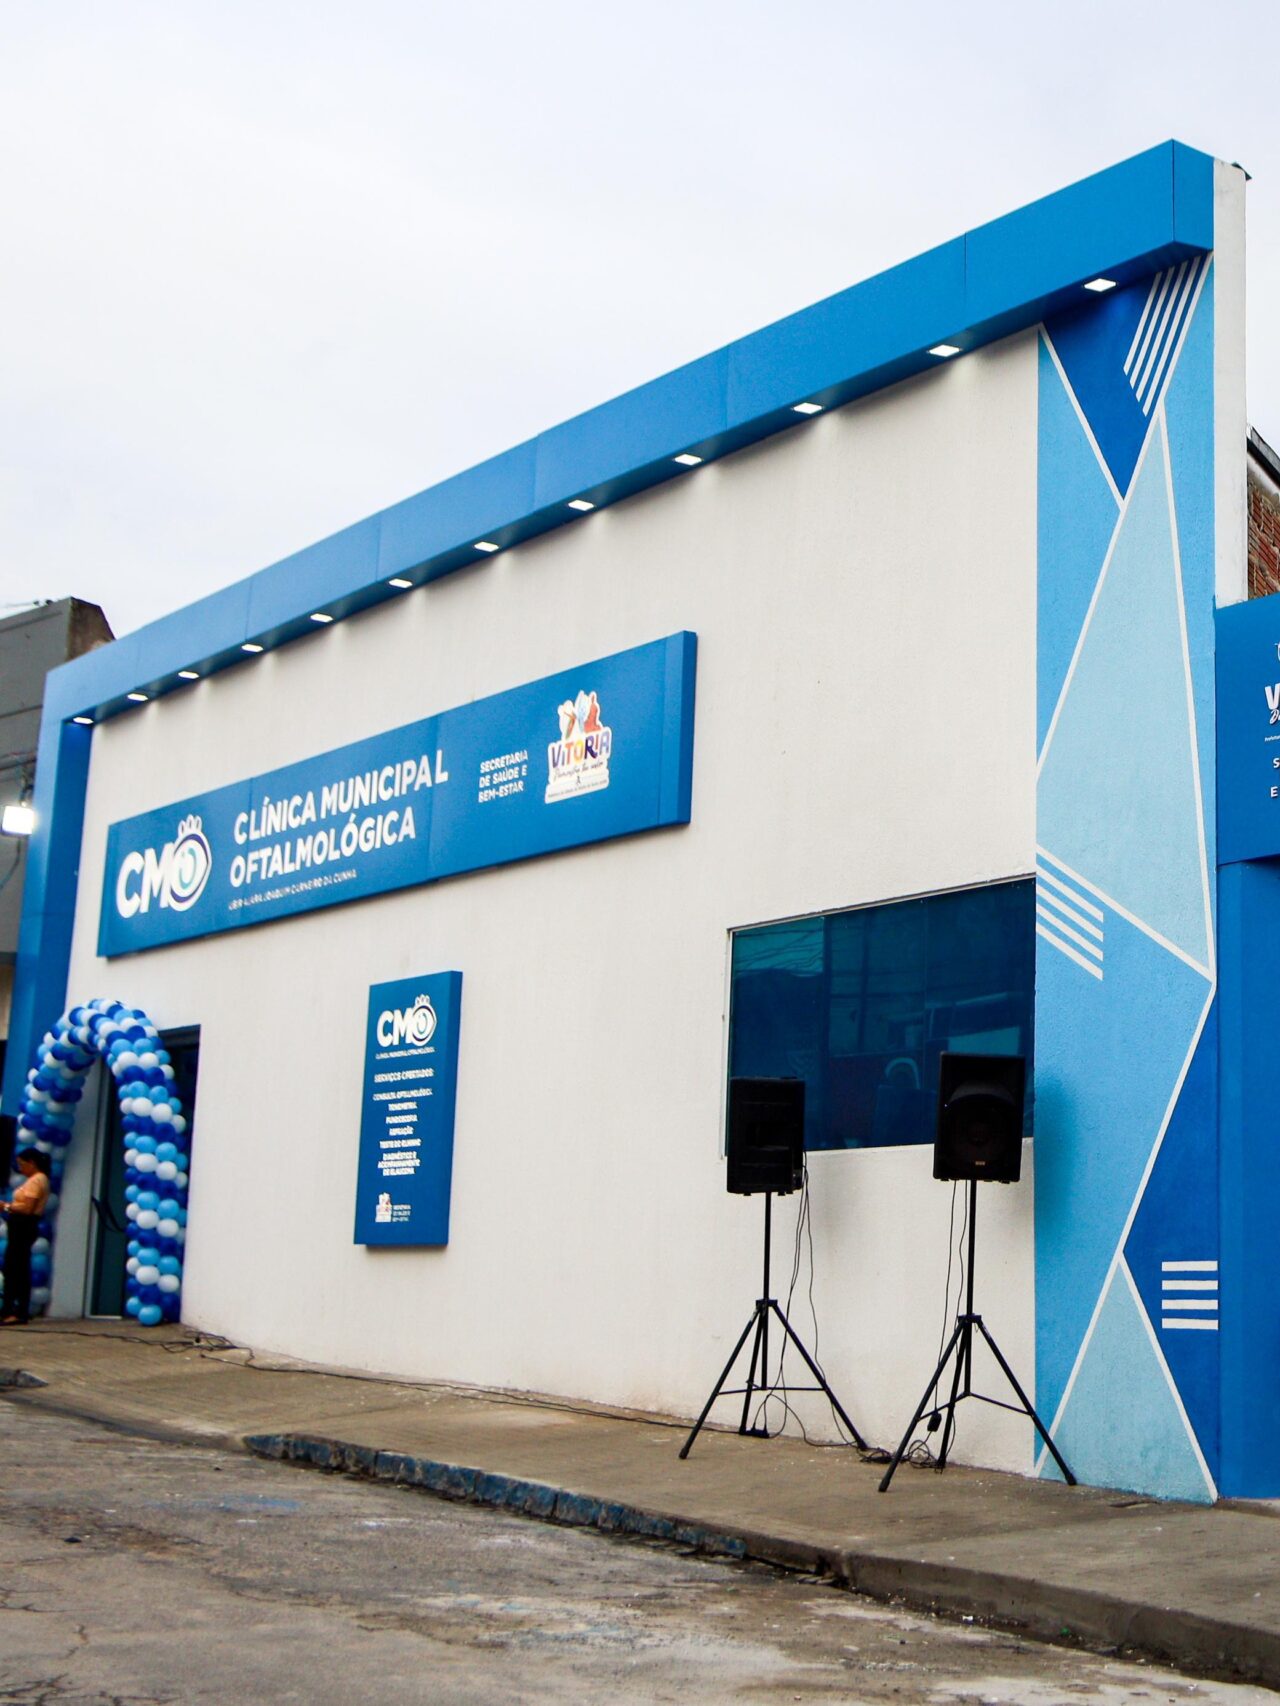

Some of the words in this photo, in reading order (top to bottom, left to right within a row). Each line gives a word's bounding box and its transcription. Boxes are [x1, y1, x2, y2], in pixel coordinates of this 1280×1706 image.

[480, 749, 529, 774] SECRETARIA
[479, 775, 491, 788] DE
[493, 767, 519, 785] SAÚDE
[521, 765, 527, 776] E
[233, 791, 316, 845] CLÍNICA
[320, 749, 448, 819] MUNICIPAL
[478, 780, 524, 803] BEM-ESTAR
[1270, 785, 1279, 798] E
[229, 806, 416, 887] OFTALMOLÓGICA
